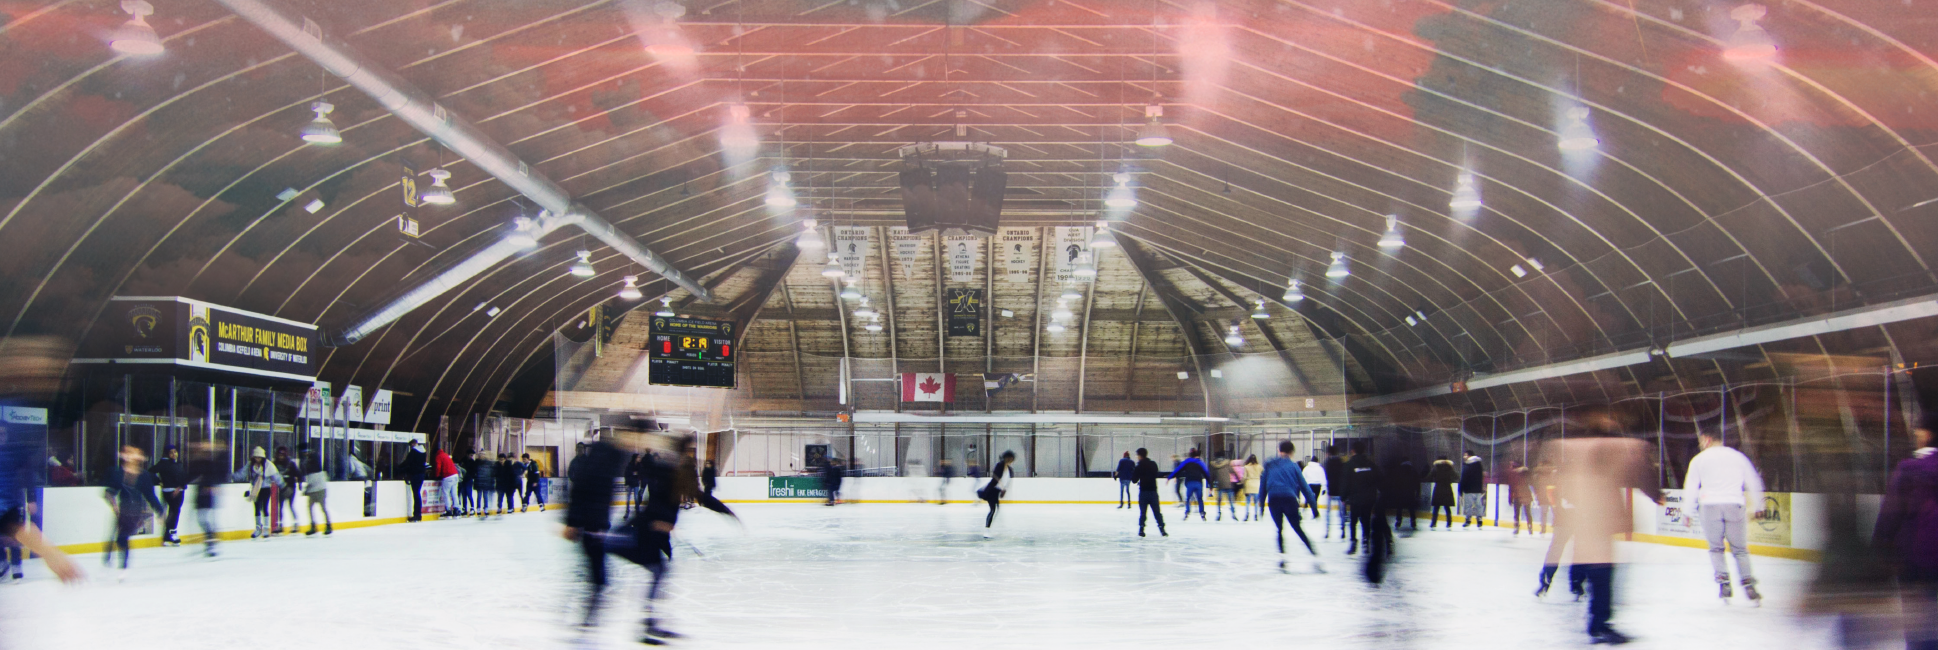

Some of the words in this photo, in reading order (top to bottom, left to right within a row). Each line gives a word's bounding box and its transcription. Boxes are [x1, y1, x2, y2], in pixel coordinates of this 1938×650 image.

[401, 176, 416, 207] 12
[255, 328, 276, 347] FAMILY
[277, 332, 295, 351] MEDIA
[296, 335, 308, 352] BOX
[770, 480, 794, 496] freshii
